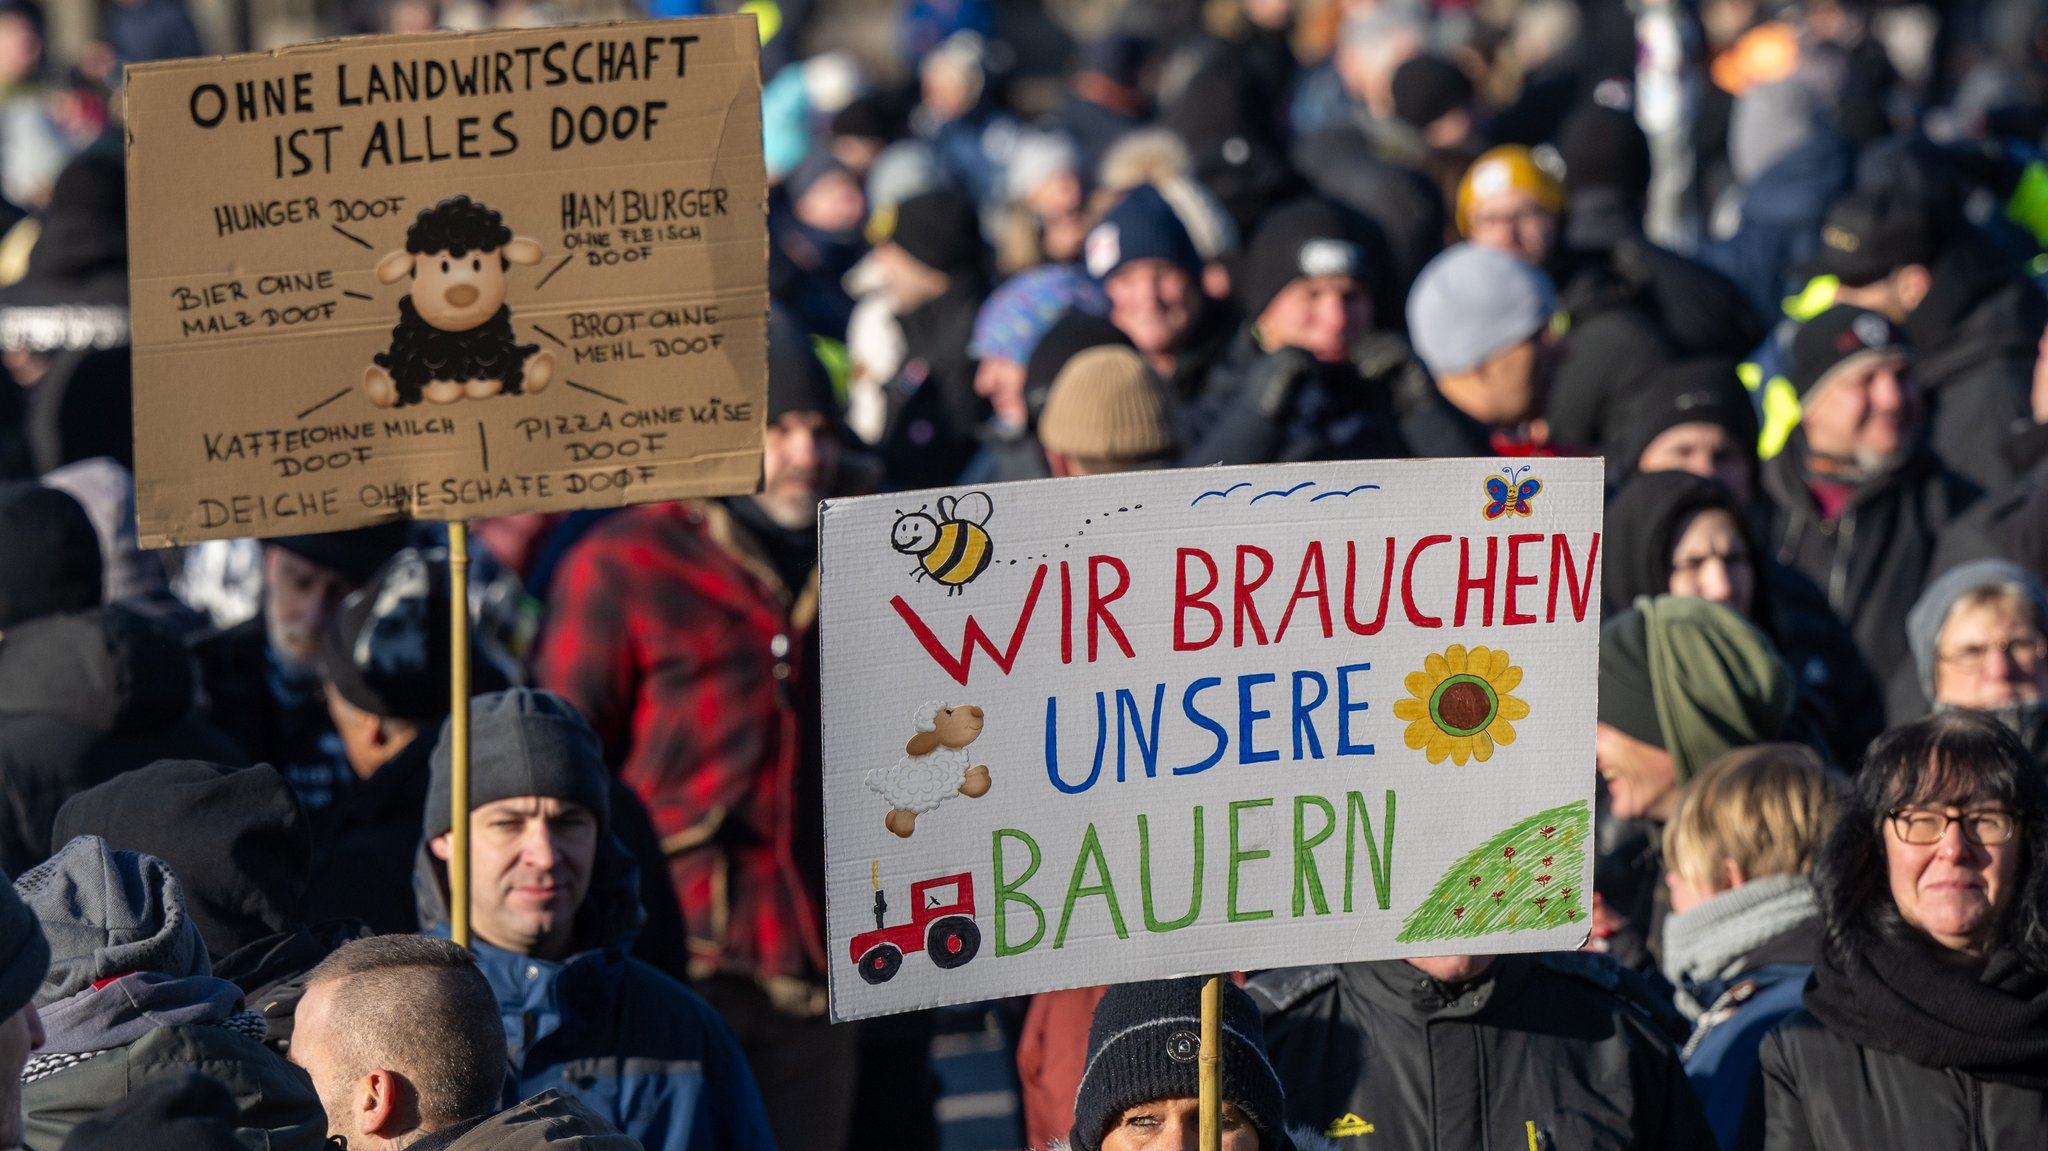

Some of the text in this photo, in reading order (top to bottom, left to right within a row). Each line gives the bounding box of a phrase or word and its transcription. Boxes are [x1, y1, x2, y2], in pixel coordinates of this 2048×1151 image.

[188, 35, 700, 130] OHNE LANDWIRTSCHAFT
[274, 101, 668, 179] IST ALLES DOOF
[214, 196, 406, 238] HUNGER DOOF
[561, 187, 728, 230] HAMBURGER
[563, 225, 701, 250] OHNE FLEISCH
[586, 247, 652, 266] DOOF
[171, 270, 334, 312] BIER OHNE
[182, 301, 337, 337] MALZ DOOF
[566, 306, 720, 339] BROT OHNE
[573, 334, 724, 364] MEHL DOOF
[203, 418, 455, 462] KAFFEE OHNE MILCH
[515, 398, 752, 441] PIZZA OHNE KÄSE
[273, 446, 373, 477] DOOF
[564, 432, 668, 462] DOOF
[199, 466, 656, 528] DEICHE OHNE SCHAFE DOOF
[890, 533, 1600, 686] WIR BRAUCHEN
[1046, 662, 1375, 794] UNSERE
[993, 789, 1396, 957] BAUERN
